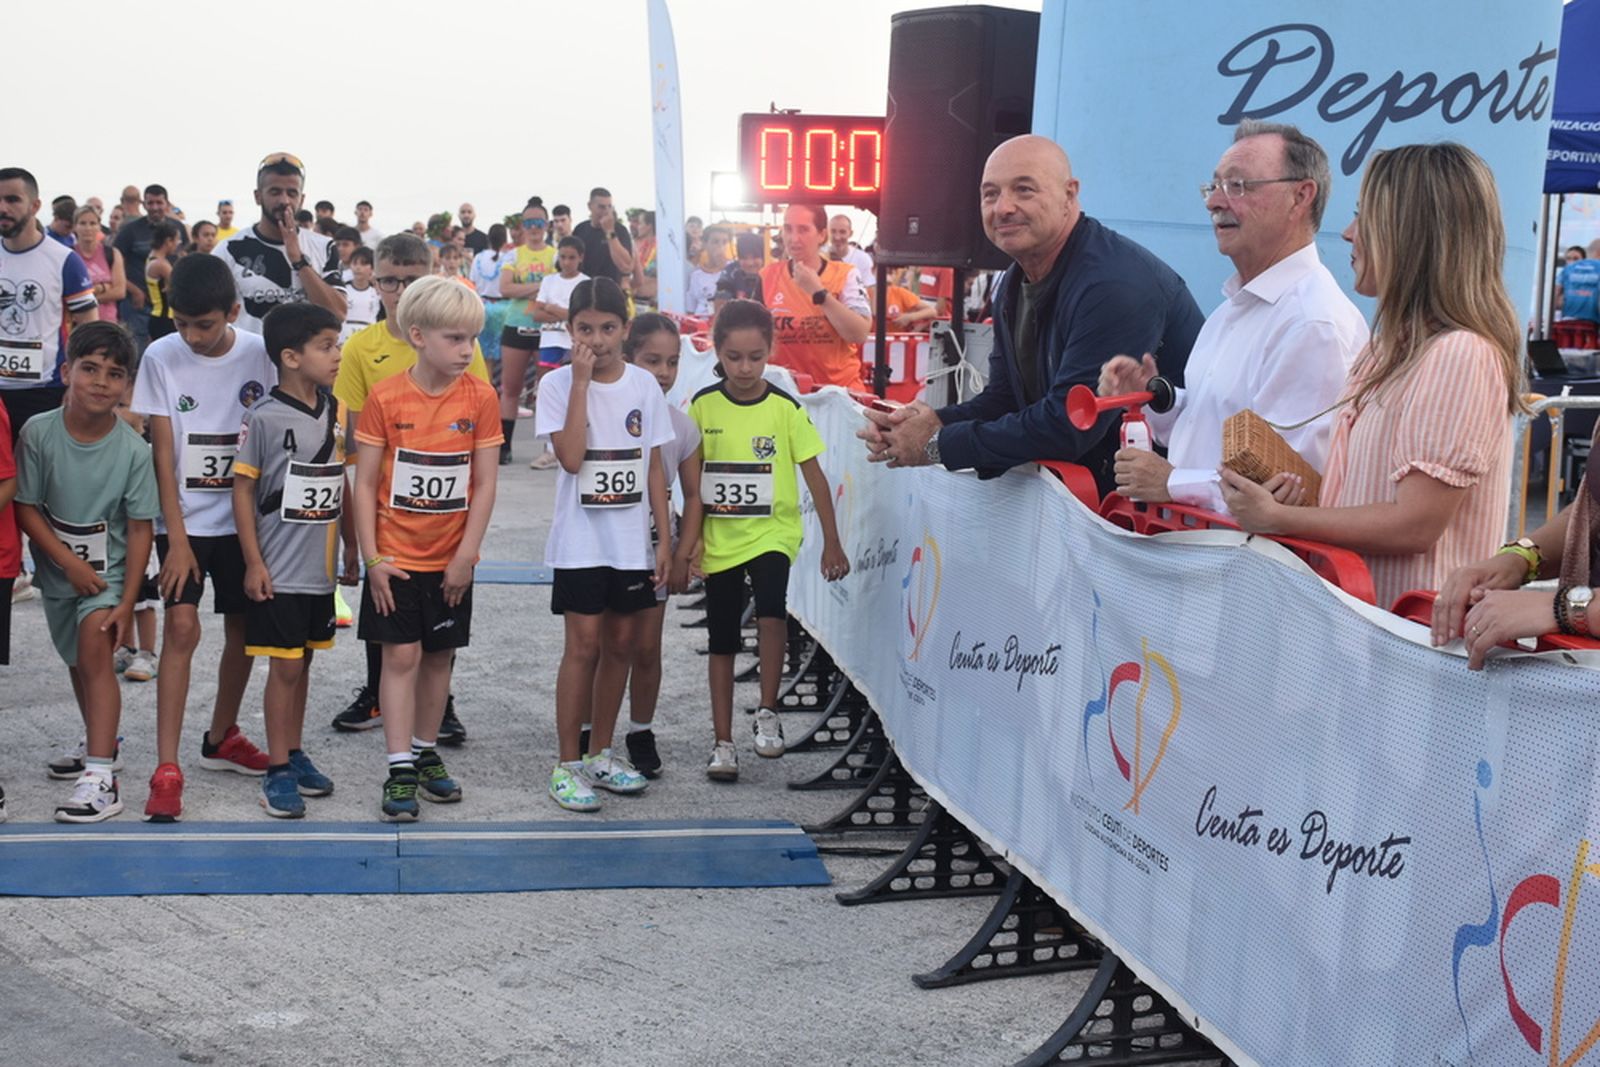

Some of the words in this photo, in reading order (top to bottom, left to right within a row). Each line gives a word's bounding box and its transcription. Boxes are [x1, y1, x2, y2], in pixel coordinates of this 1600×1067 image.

[1217, 23, 1557, 176] Deporte
[761, 128, 881, 191] 00:0
[1547, 150, 1600, 163] EPORTIV
[240, 254, 266, 278] 26
[0, 354, 31, 371] 264
[283, 429, 297, 453] 4
[409, 475, 456, 499] 307
[594, 470, 636, 493] 369
[302, 487, 341, 509] 324
[713, 483, 758, 505] 335
[987, 651, 1000, 673] es
[1004, 634, 1062, 693] Deporte
[1195, 784, 1263, 847] Ceuta
[1267, 827, 1292, 857] es
[1299, 810, 1411, 894] Deporte
